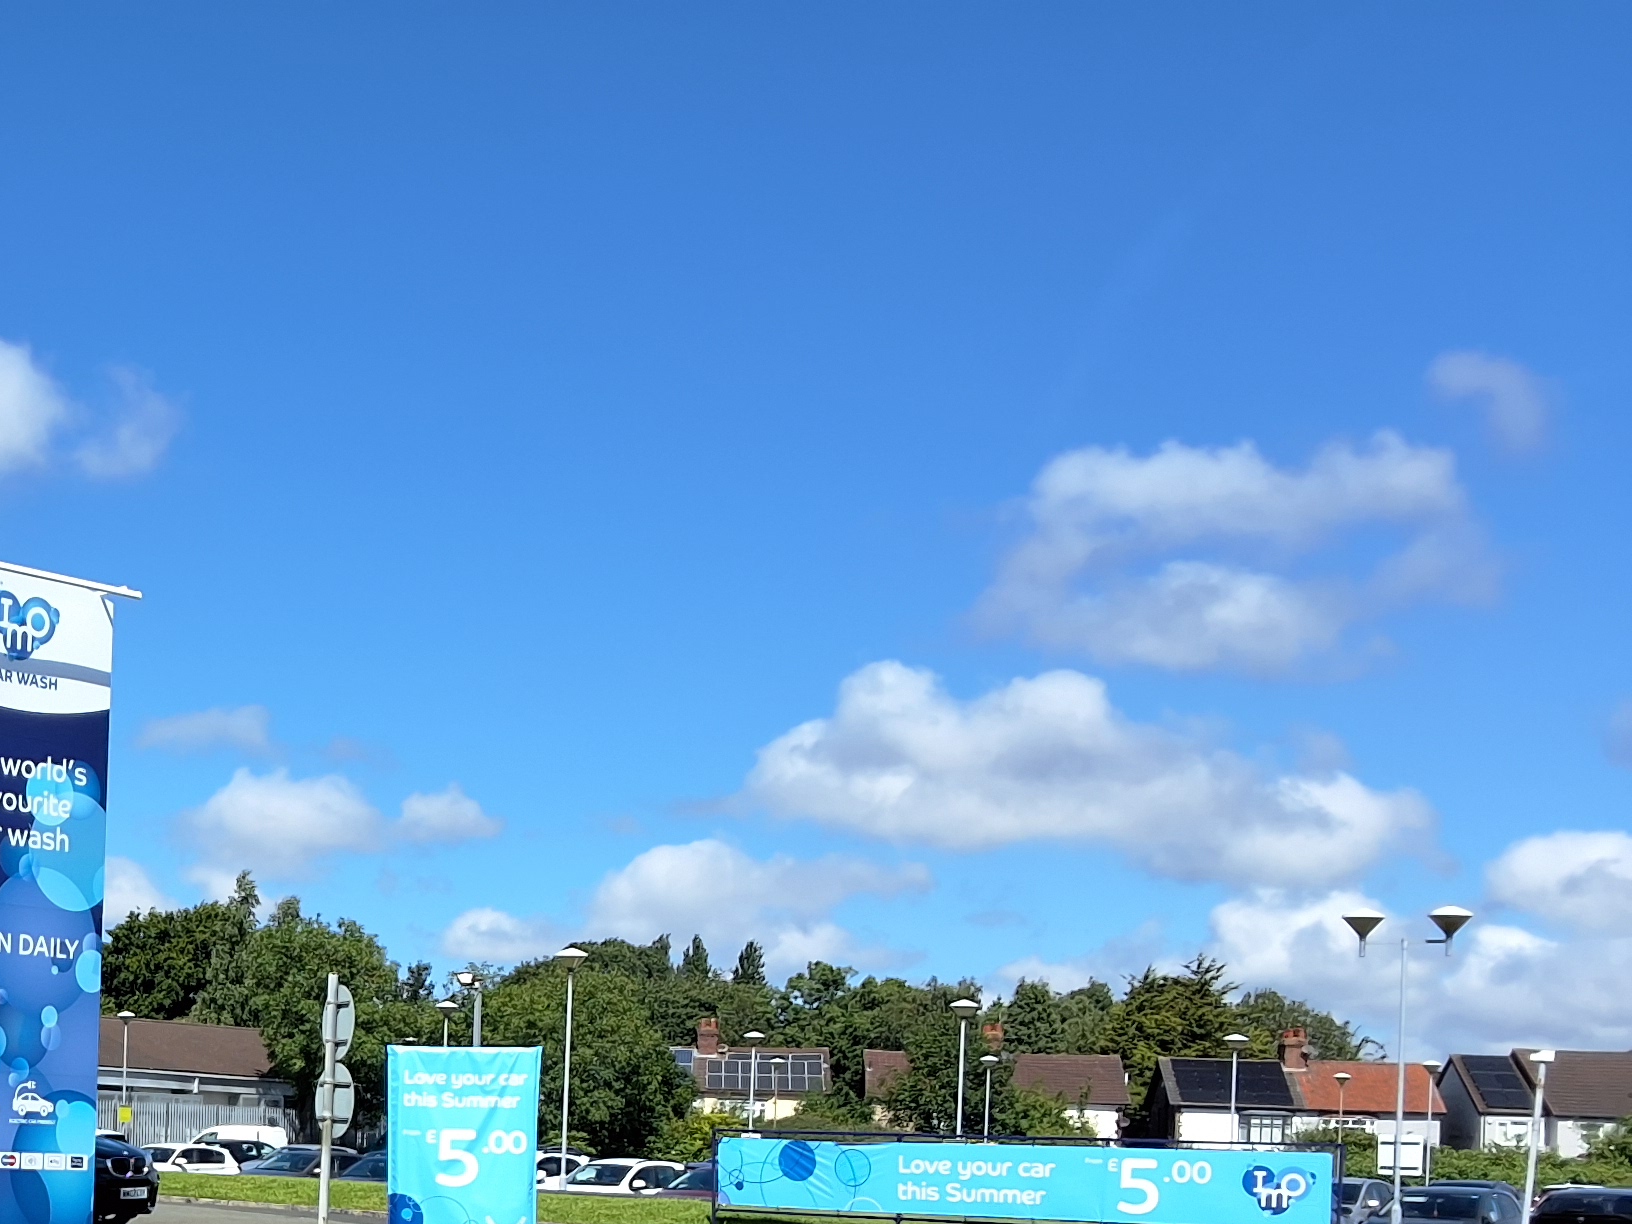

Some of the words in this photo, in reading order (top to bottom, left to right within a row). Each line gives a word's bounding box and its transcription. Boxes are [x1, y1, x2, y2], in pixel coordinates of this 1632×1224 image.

[16, 671, 58, 691] WASH
[0, 755, 88, 787] world's
[7, 827, 69, 853] wash
[19, 934, 79, 960] DAILY
[403, 1069, 447, 1085] Love
[451, 1072, 495, 1089] your
[498, 1073, 528, 1086] car
[403, 1091, 438, 1108] this
[441, 1092, 521, 1109] Summer
[898, 1155, 952, 1175] Love
[957, 1160, 1013, 1181] your
[1018, 1162, 1056, 1178] car
[897, 1181, 940, 1202] this
[945, 1182, 1047, 1206] Summer
